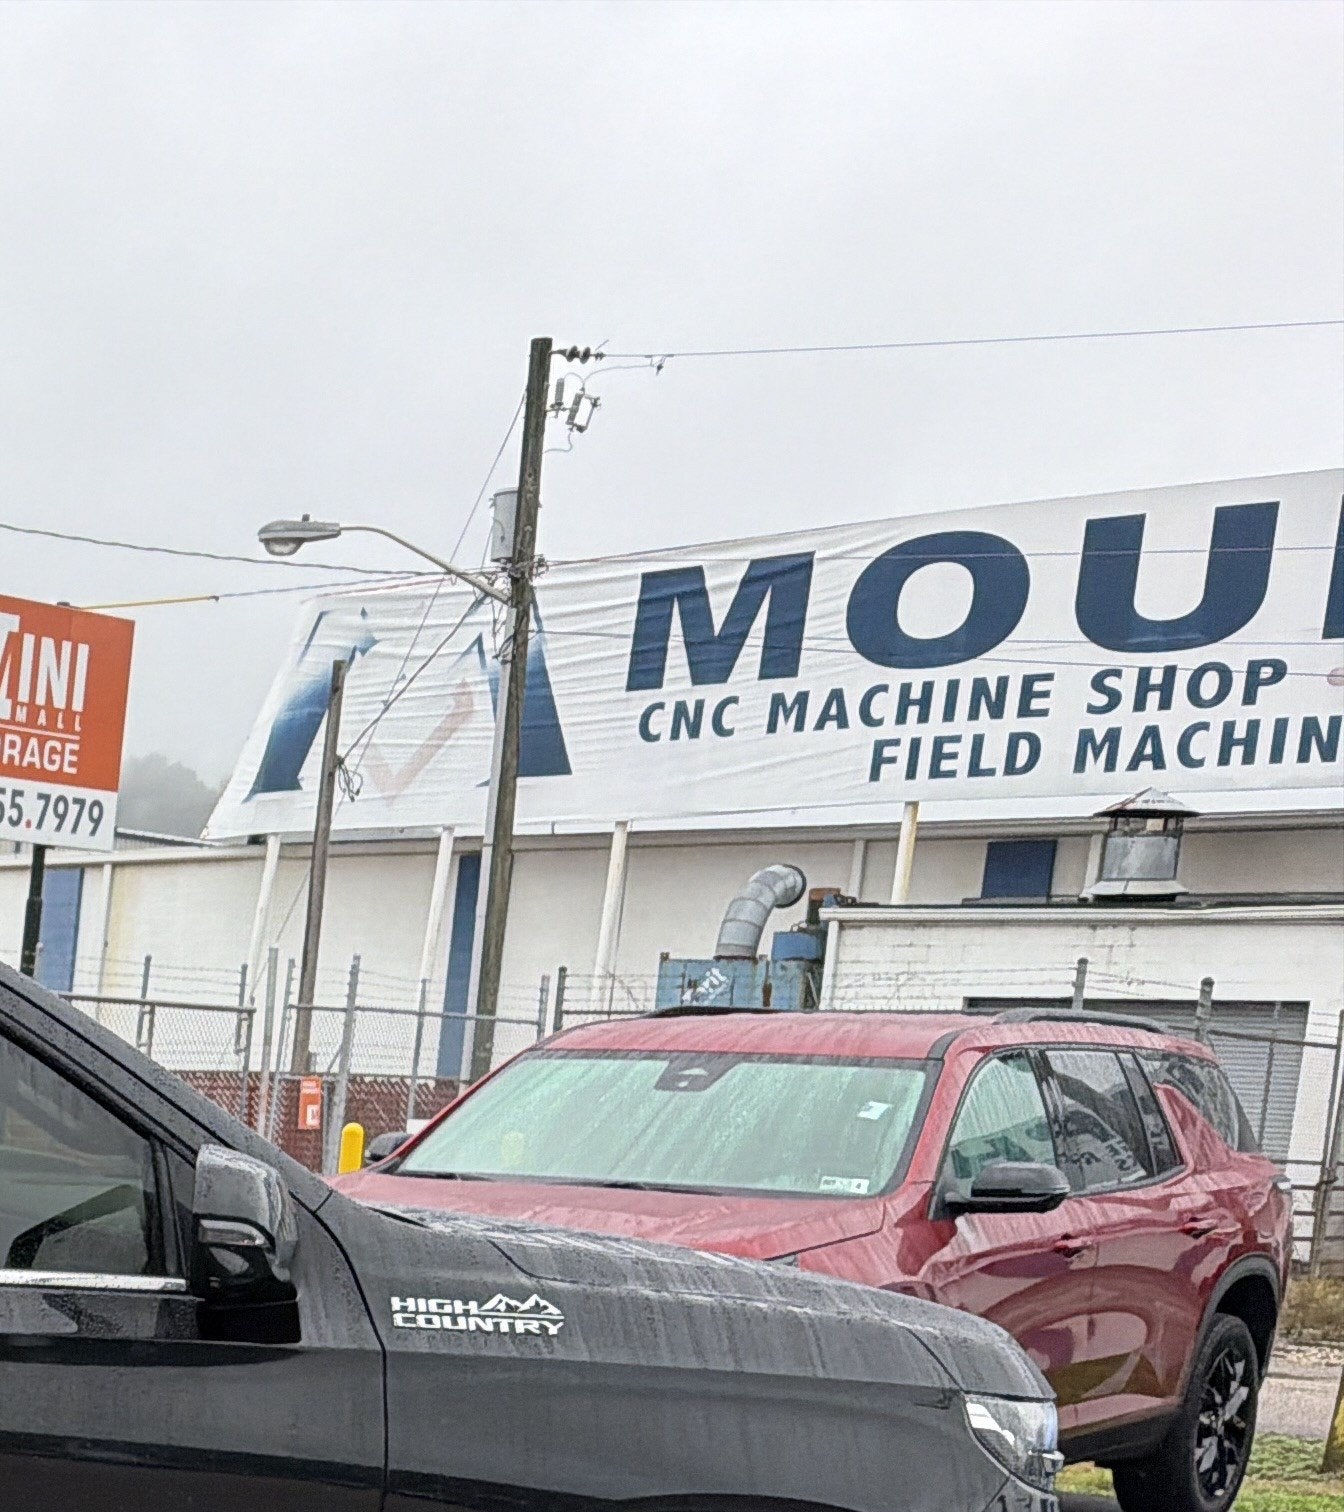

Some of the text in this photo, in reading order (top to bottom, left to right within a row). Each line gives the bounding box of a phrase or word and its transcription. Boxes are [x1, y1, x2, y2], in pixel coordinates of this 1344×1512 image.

[625, 494, 1344, 692] MOU
[14, 704, 82, 732] MALL
[638, 657, 1289, 744] CNC MACHINE SHOP
[868, 729, 1043, 784] FIELD
[390, 1296, 478, 1315] HIGH
[392, 1313, 565, 1336] COUNTRY
